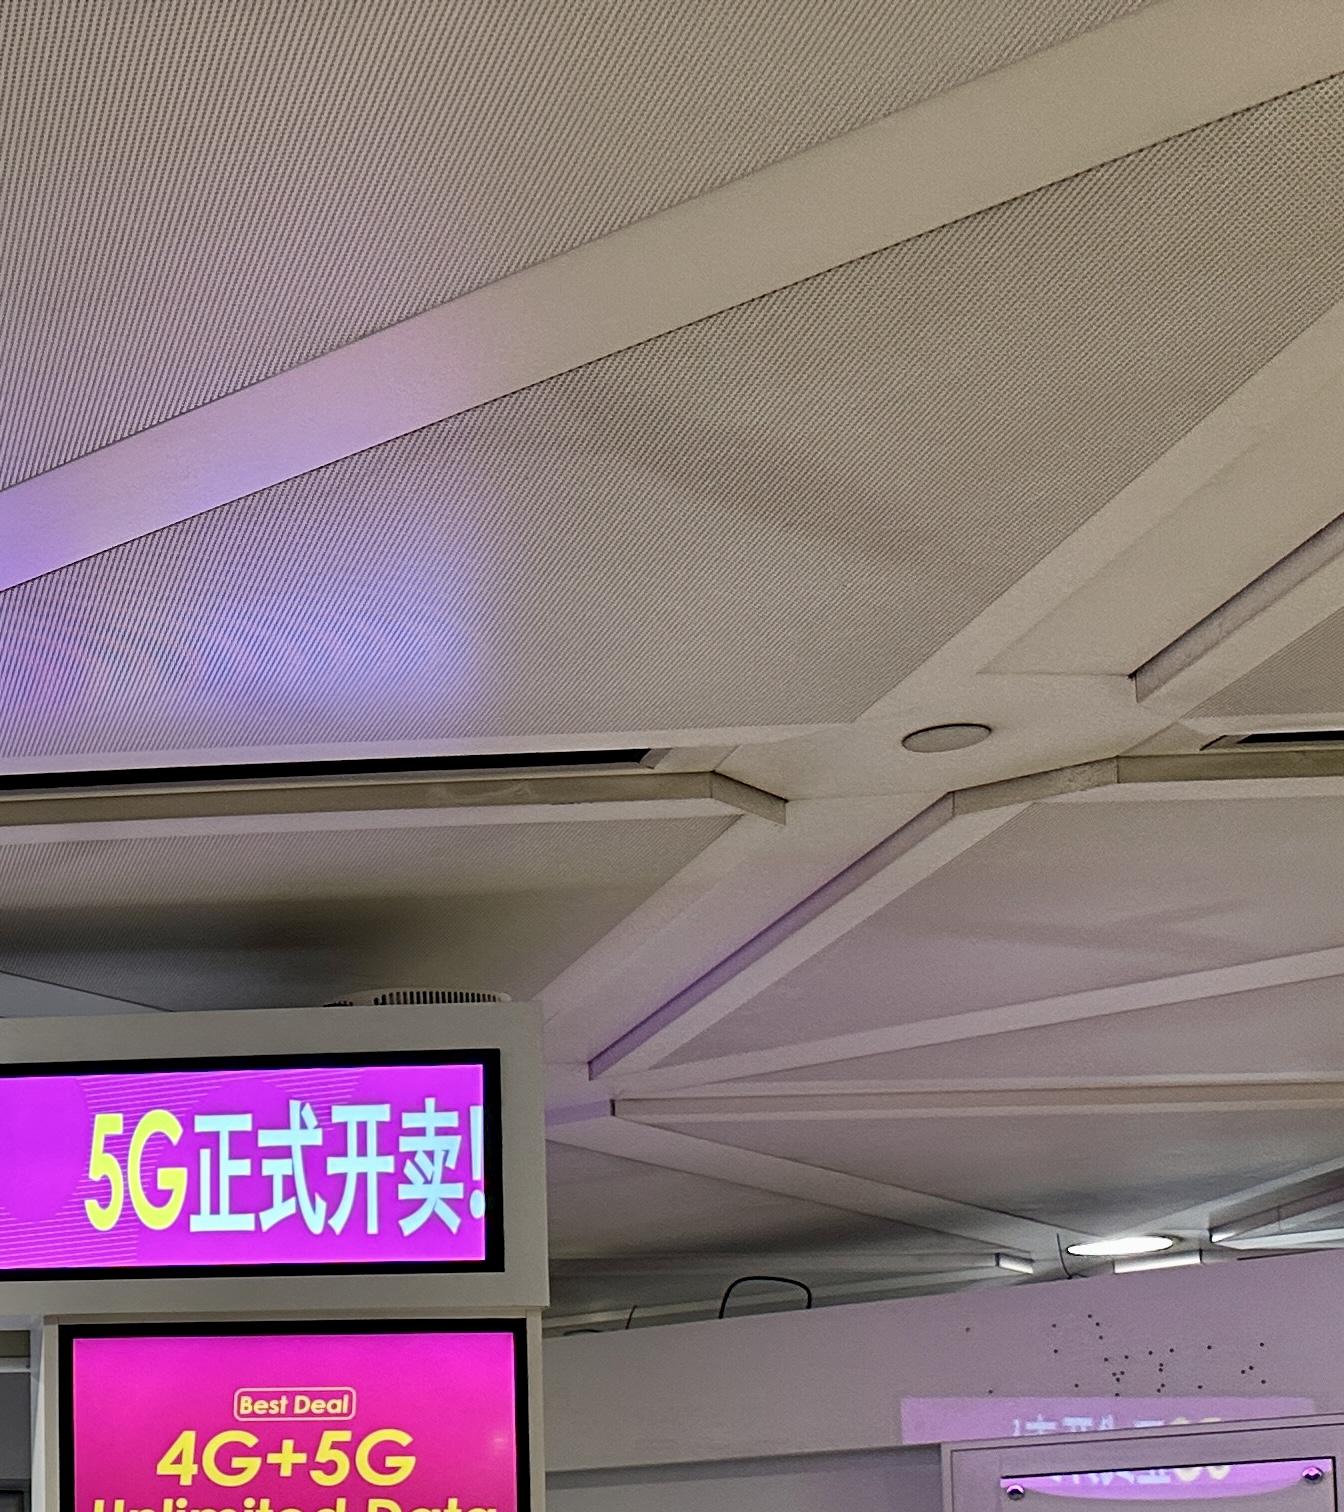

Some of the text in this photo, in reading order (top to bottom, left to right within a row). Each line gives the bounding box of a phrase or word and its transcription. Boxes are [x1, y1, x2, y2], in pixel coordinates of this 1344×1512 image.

[239, 1394, 349, 1415] Best Deal
[156, 1429, 417, 1487] 4G+5G
